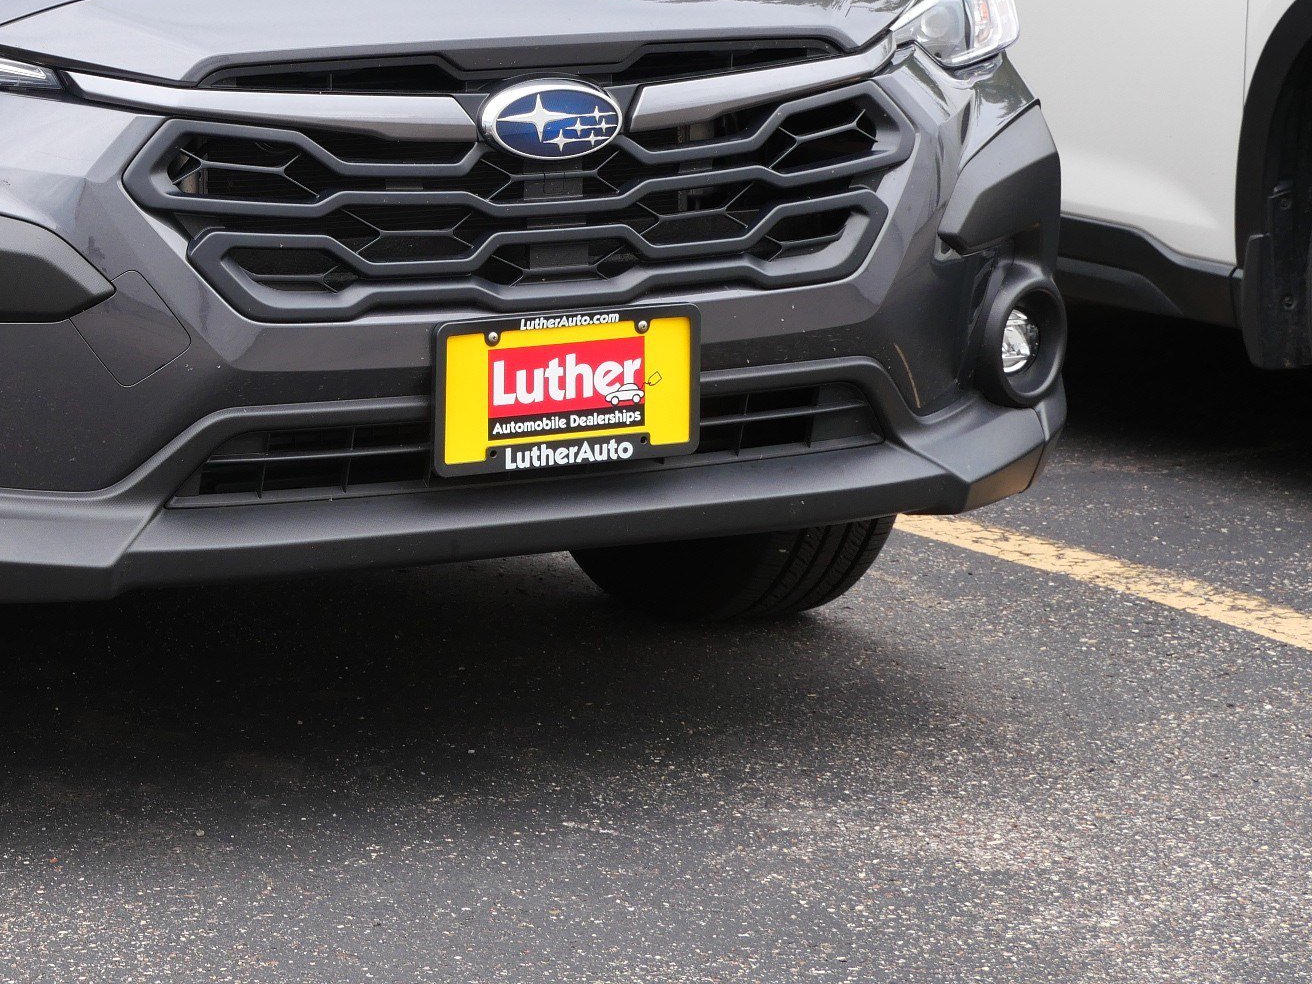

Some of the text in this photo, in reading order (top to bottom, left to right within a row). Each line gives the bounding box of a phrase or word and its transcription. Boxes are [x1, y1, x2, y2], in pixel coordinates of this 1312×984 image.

[520, 312, 620, 331] LutherAuto.com
[492, 353, 642, 406] Luther
[492, 409, 642, 435] Automobile Dealerships
[504, 439, 634, 470] LutherAuto
